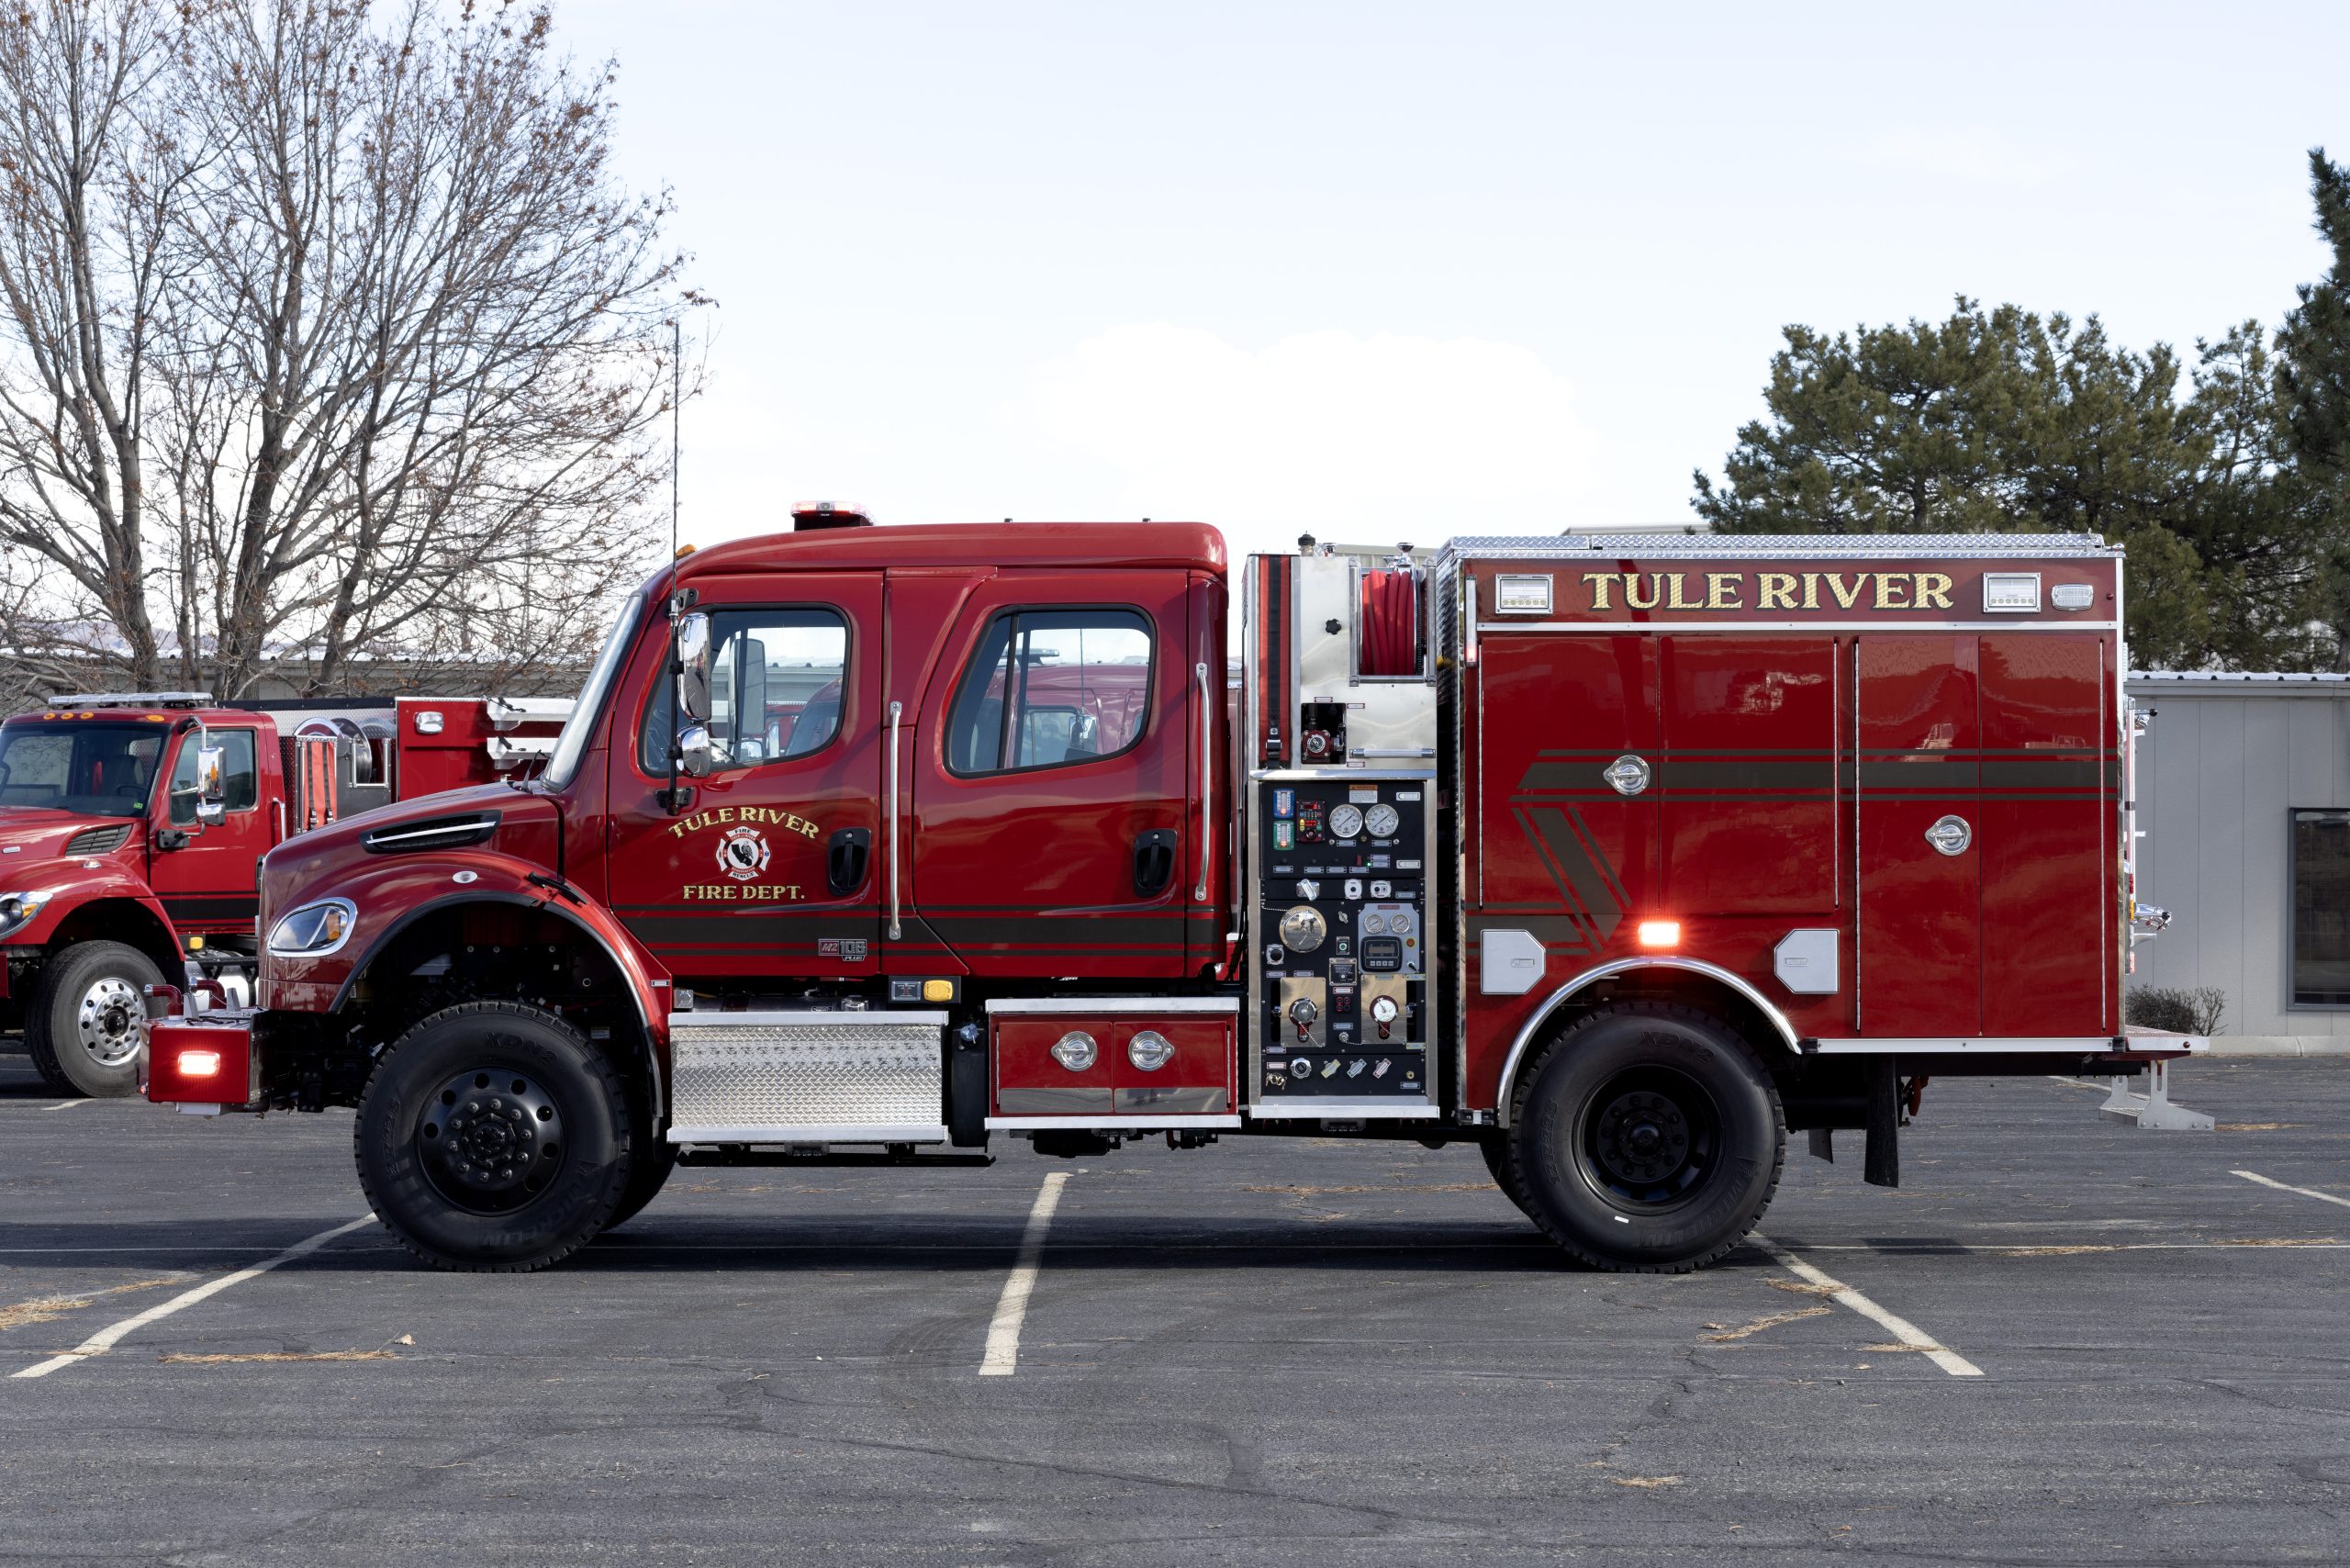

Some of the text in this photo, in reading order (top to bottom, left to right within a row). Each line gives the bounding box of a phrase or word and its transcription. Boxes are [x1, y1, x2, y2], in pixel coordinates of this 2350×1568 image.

[1581, 571, 1955, 611] TULE RIVER
[668, 806, 820, 839] TULE RIVER
[683, 885, 805, 900] FIRE DEPT.
[822, 943, 839, 952] M2
